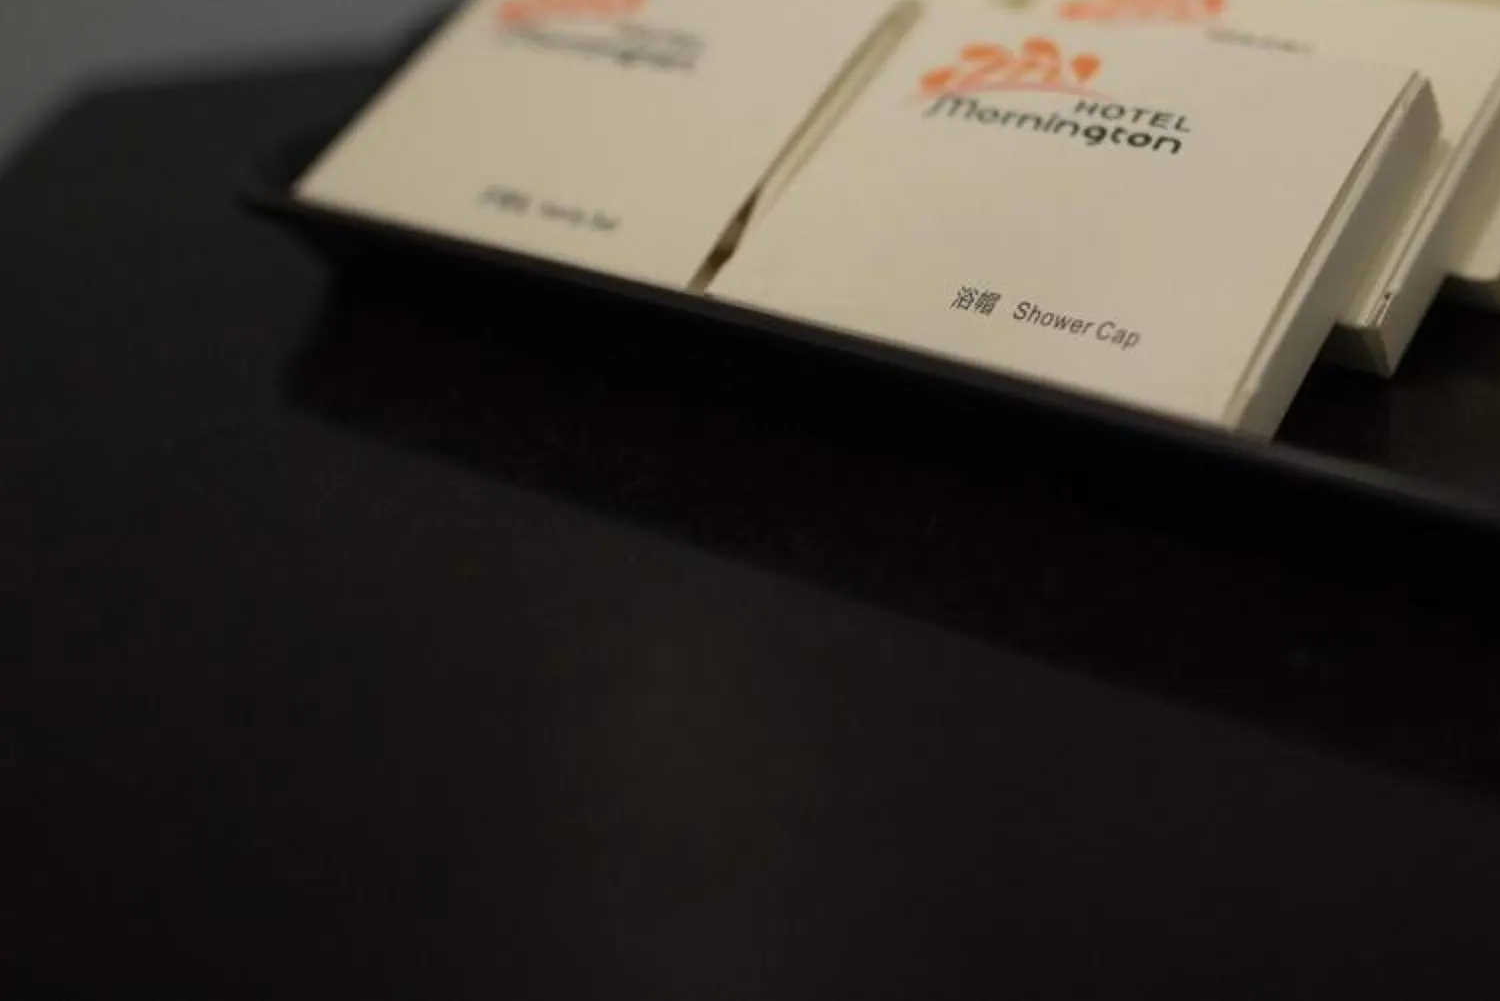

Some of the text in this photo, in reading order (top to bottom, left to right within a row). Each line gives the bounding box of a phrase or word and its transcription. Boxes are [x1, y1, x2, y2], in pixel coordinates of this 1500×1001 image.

[922, 91, 1183, 155] Mornington
[1073, 99, 1192, 133] HOTEL
[950, 286, 1142, 350] 浴帽 Shower Cap
